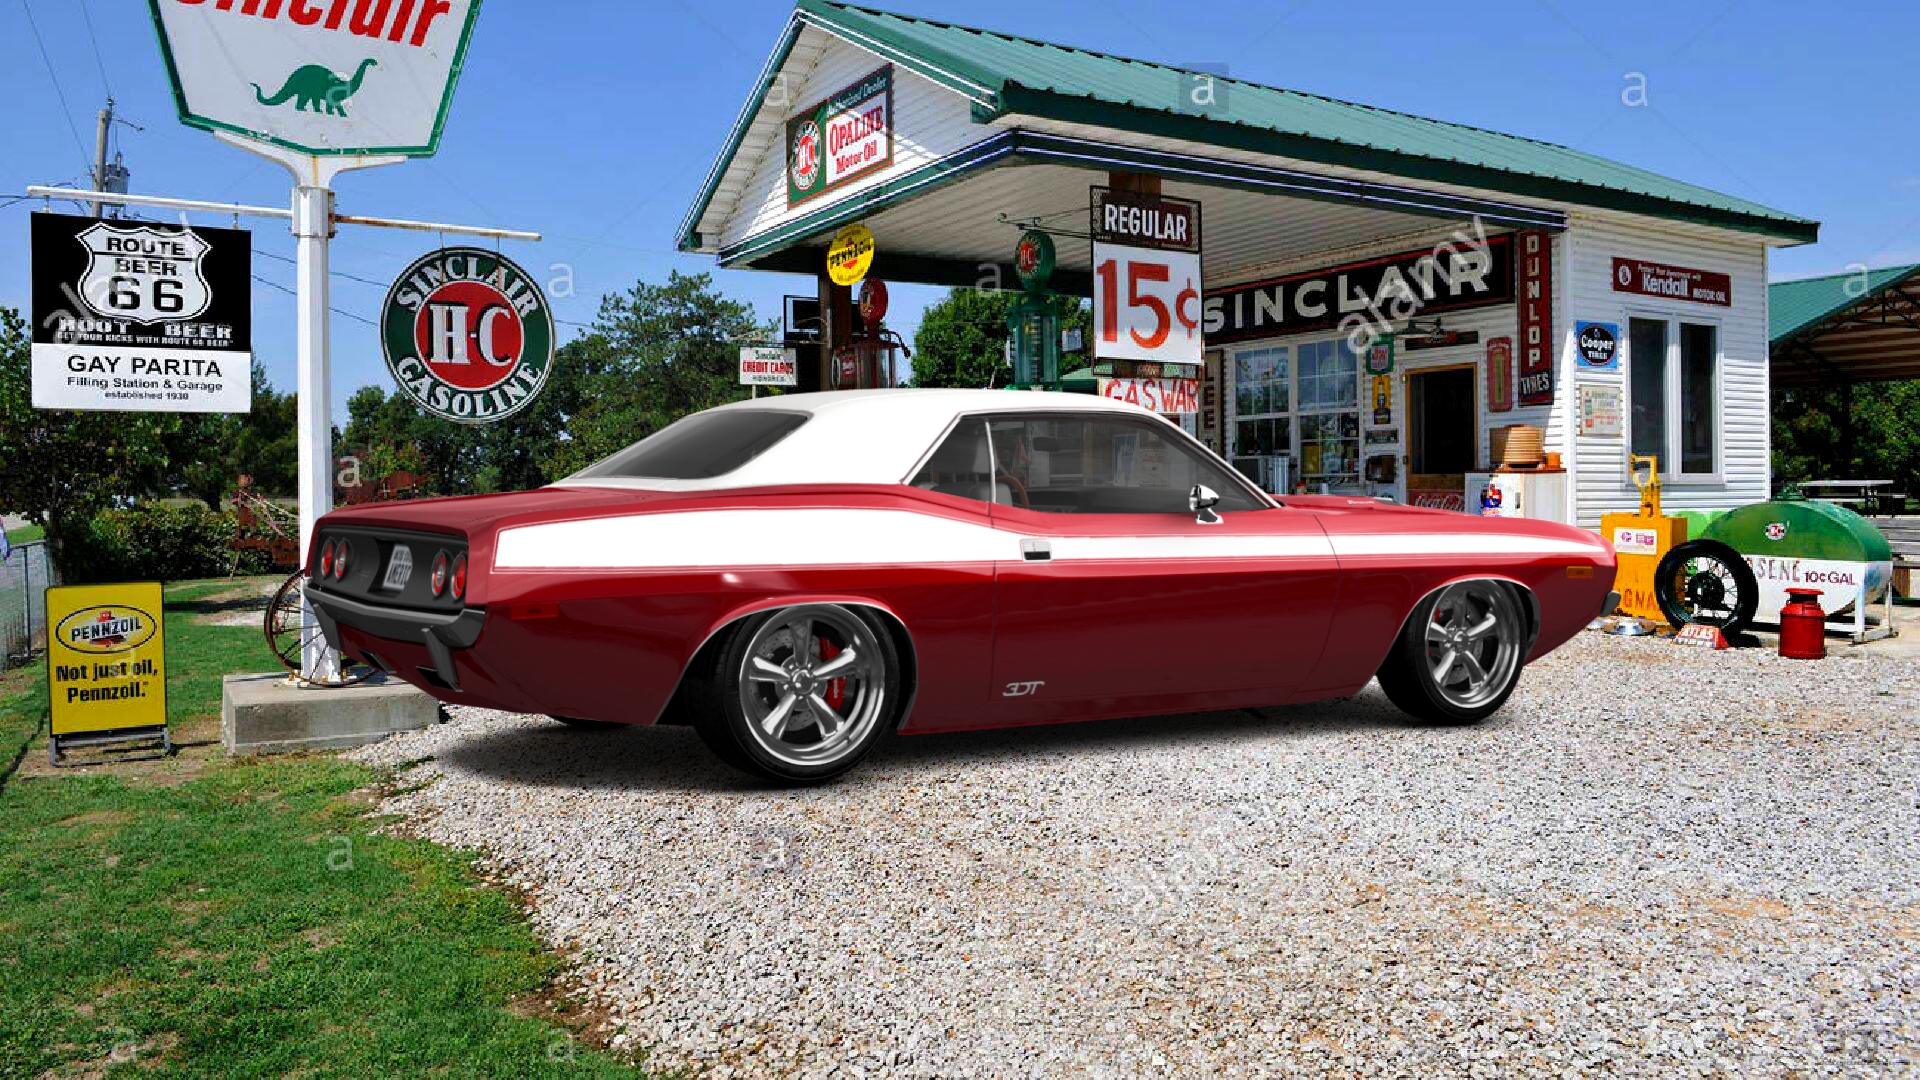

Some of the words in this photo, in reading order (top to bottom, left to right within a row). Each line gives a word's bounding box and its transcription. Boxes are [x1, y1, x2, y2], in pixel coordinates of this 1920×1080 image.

[829, 105, 884, 156] OPALINE
[836, 152, 862, 174] Motor
[864, 140, 878, 162] Oil
[1104, 203, 1188, 242] REGULAR
[107, 237, 186, 256] ROUTE
[115, 257, 178, 277] BEER
[108, 275, 184, 313] 66
[397, 256, 540, 318] SINCLAIR
[1204, 250, 1489, 333] SINCLAIR
[1642, 272, 1689, 296] Kendall
[1096, 258, 1199, 349] 15¢
[1526, 234, 1541, 368] DUNLOP
[163, 322, 233, 339] BEER
[429, 303, 513, 367] H-C
[1581, 334, 1614, 351] Cooper
[67, 355, 122, 374] GAY
[131, 356, 223, 378] PARITA
[66, 376, 109, 390] Filling
[113, 377, 159, 390] Station
[162, 379, 173, 390] &
[176, 380, 224, 393] Garage
[104, 390, 163, 401] established
[397, 356, 543, 417] GASOLINE
[1104, 378, 1157, 412] GAS
[1158, 378, 1200, 413] WAR
[1520, 372, 1551, 397] TIRES
[1827, 570, 1857, 587] GAL
[71, 617, 143, 642] PENNZOIL
[56, 664, 89, 682] Not
[92, 661, 128, 682] just
[132, 659, 158, 677] oil,
[67, 681, 146, 704] Pennzoil.
